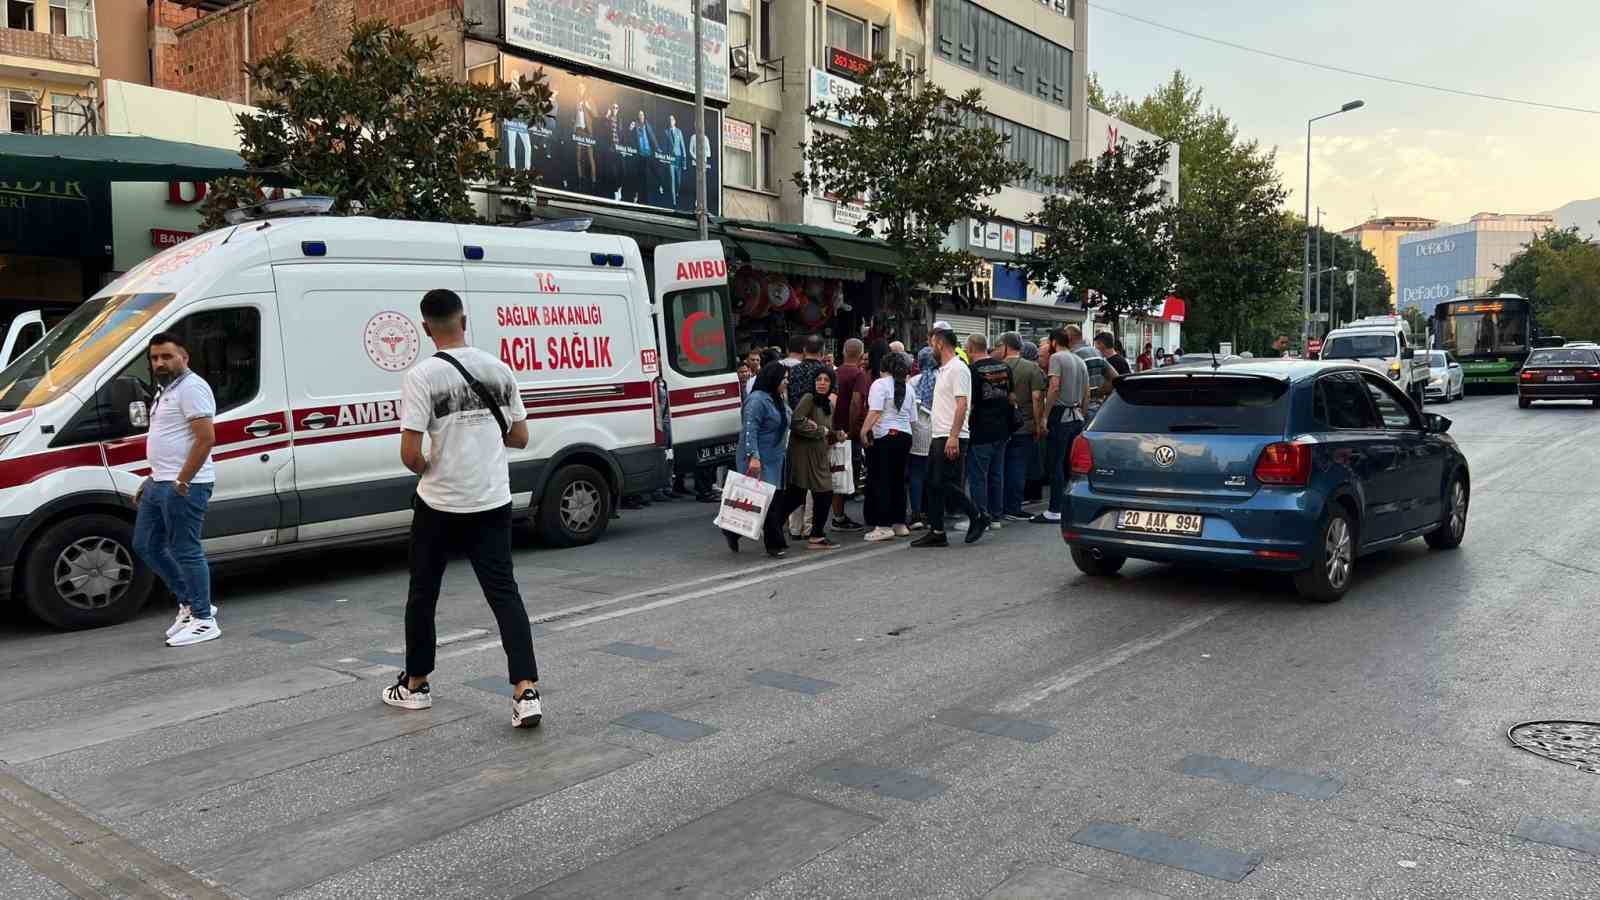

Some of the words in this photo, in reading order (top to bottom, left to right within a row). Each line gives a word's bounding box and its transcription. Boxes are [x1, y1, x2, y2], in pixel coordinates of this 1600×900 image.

[676, 260, 726, 281] AMBU
[536, 272, 560, 293] T.C.
[544, 303, 602, 326] BAKANLIĞI
[548, 331, 612, 370] SAĞLIK
[643, 351, 655, 363] 112
[1125, 512, 1139, 525] 20
[1146, 513, 1169, 528] AAK
[1176, 515, 1199, 531] 994
